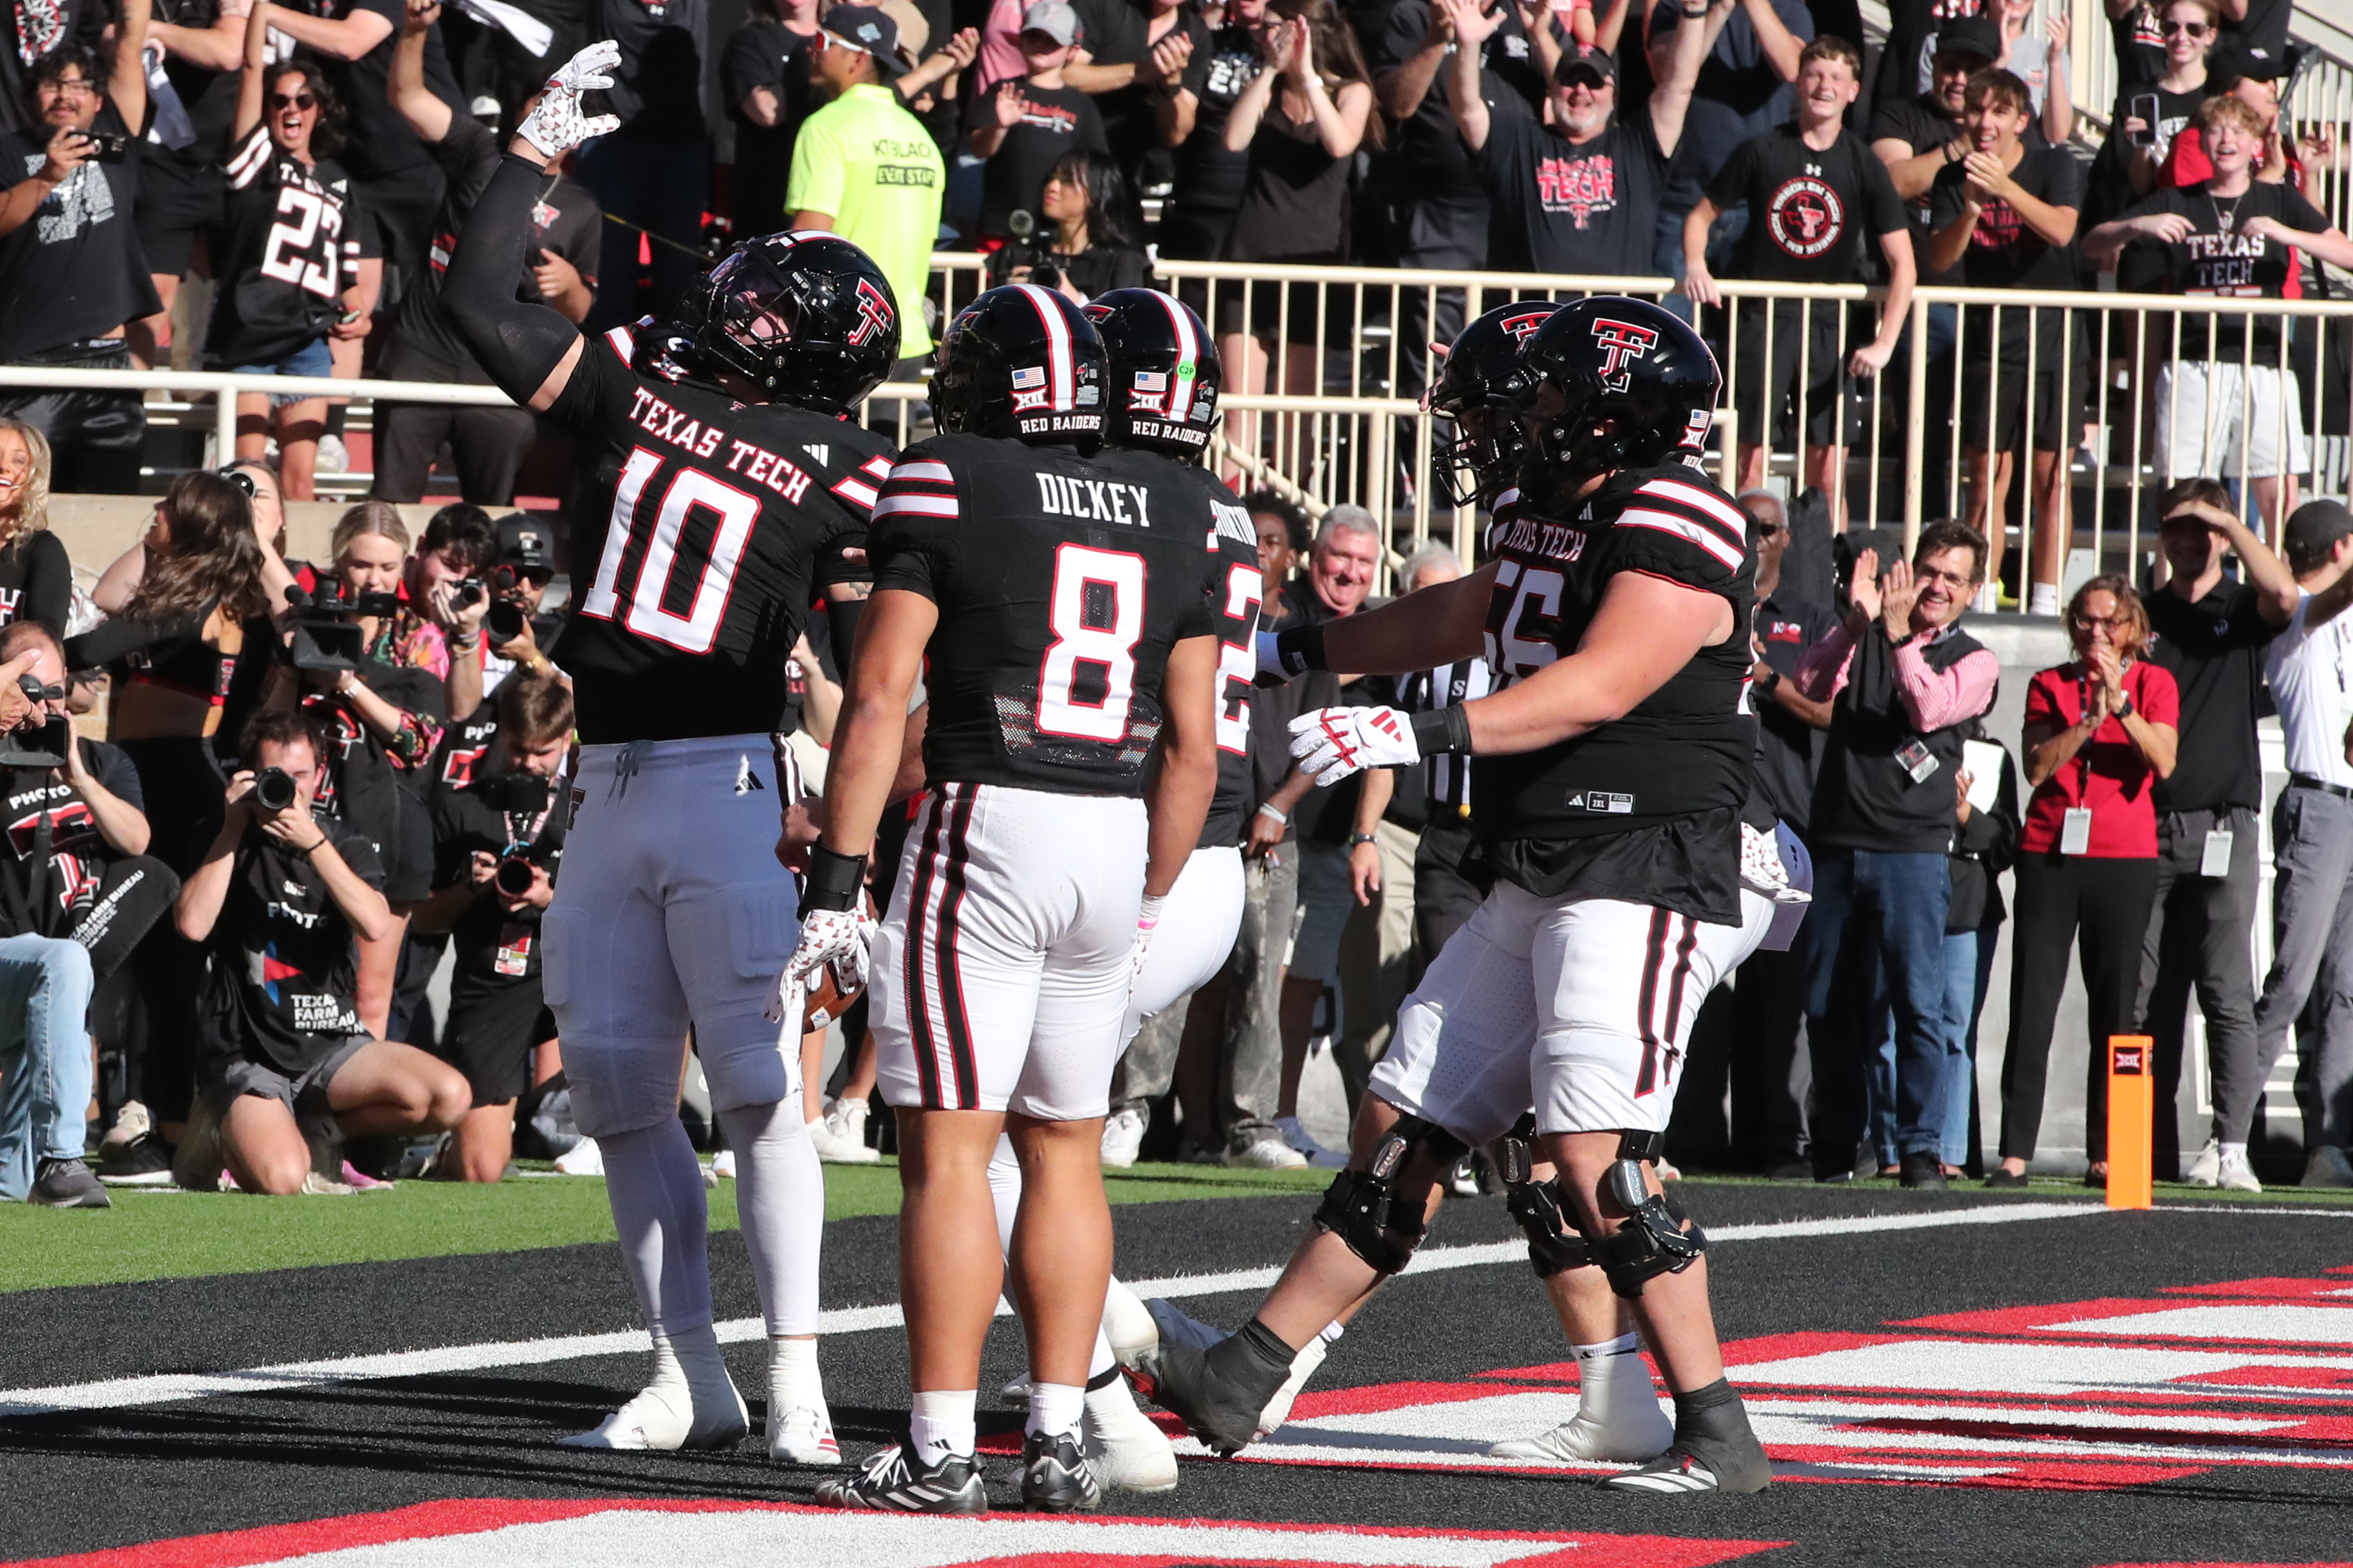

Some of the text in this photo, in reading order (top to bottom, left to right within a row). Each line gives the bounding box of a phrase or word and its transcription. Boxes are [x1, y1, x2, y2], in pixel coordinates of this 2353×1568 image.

[1537, 170, 1614, 204] TECH
[261, 186, 343, 298] 23
[2185, 230, 2265, 259] TEXAS
[2196, 259, 2254, 286] TECH
[1178, 366, 1194, 375] C2P
[1020, 416, 1101, 434] RED RAIDERS
[1132, 420, 1206, 446] RED RAIDERS
[628, 385, 813, 506] TEXAS TECH
[1035, 472, 1150, 527] DICKEY
[579, 444, 762, 656] 10
[1504, 518, 1587, 563] TEXAS TECH
[1034, 542, 1147, 744] 8
[1451, 679, 1466, 696] S
[9, 784, 72, 810] PHOTO
[1592, 799, 1605, 808] 2XL
[86, 898, 112, 925] FARM
[108, 870, 145, 903] BUREAU
[294, 1005, 339, 1021] FARM
